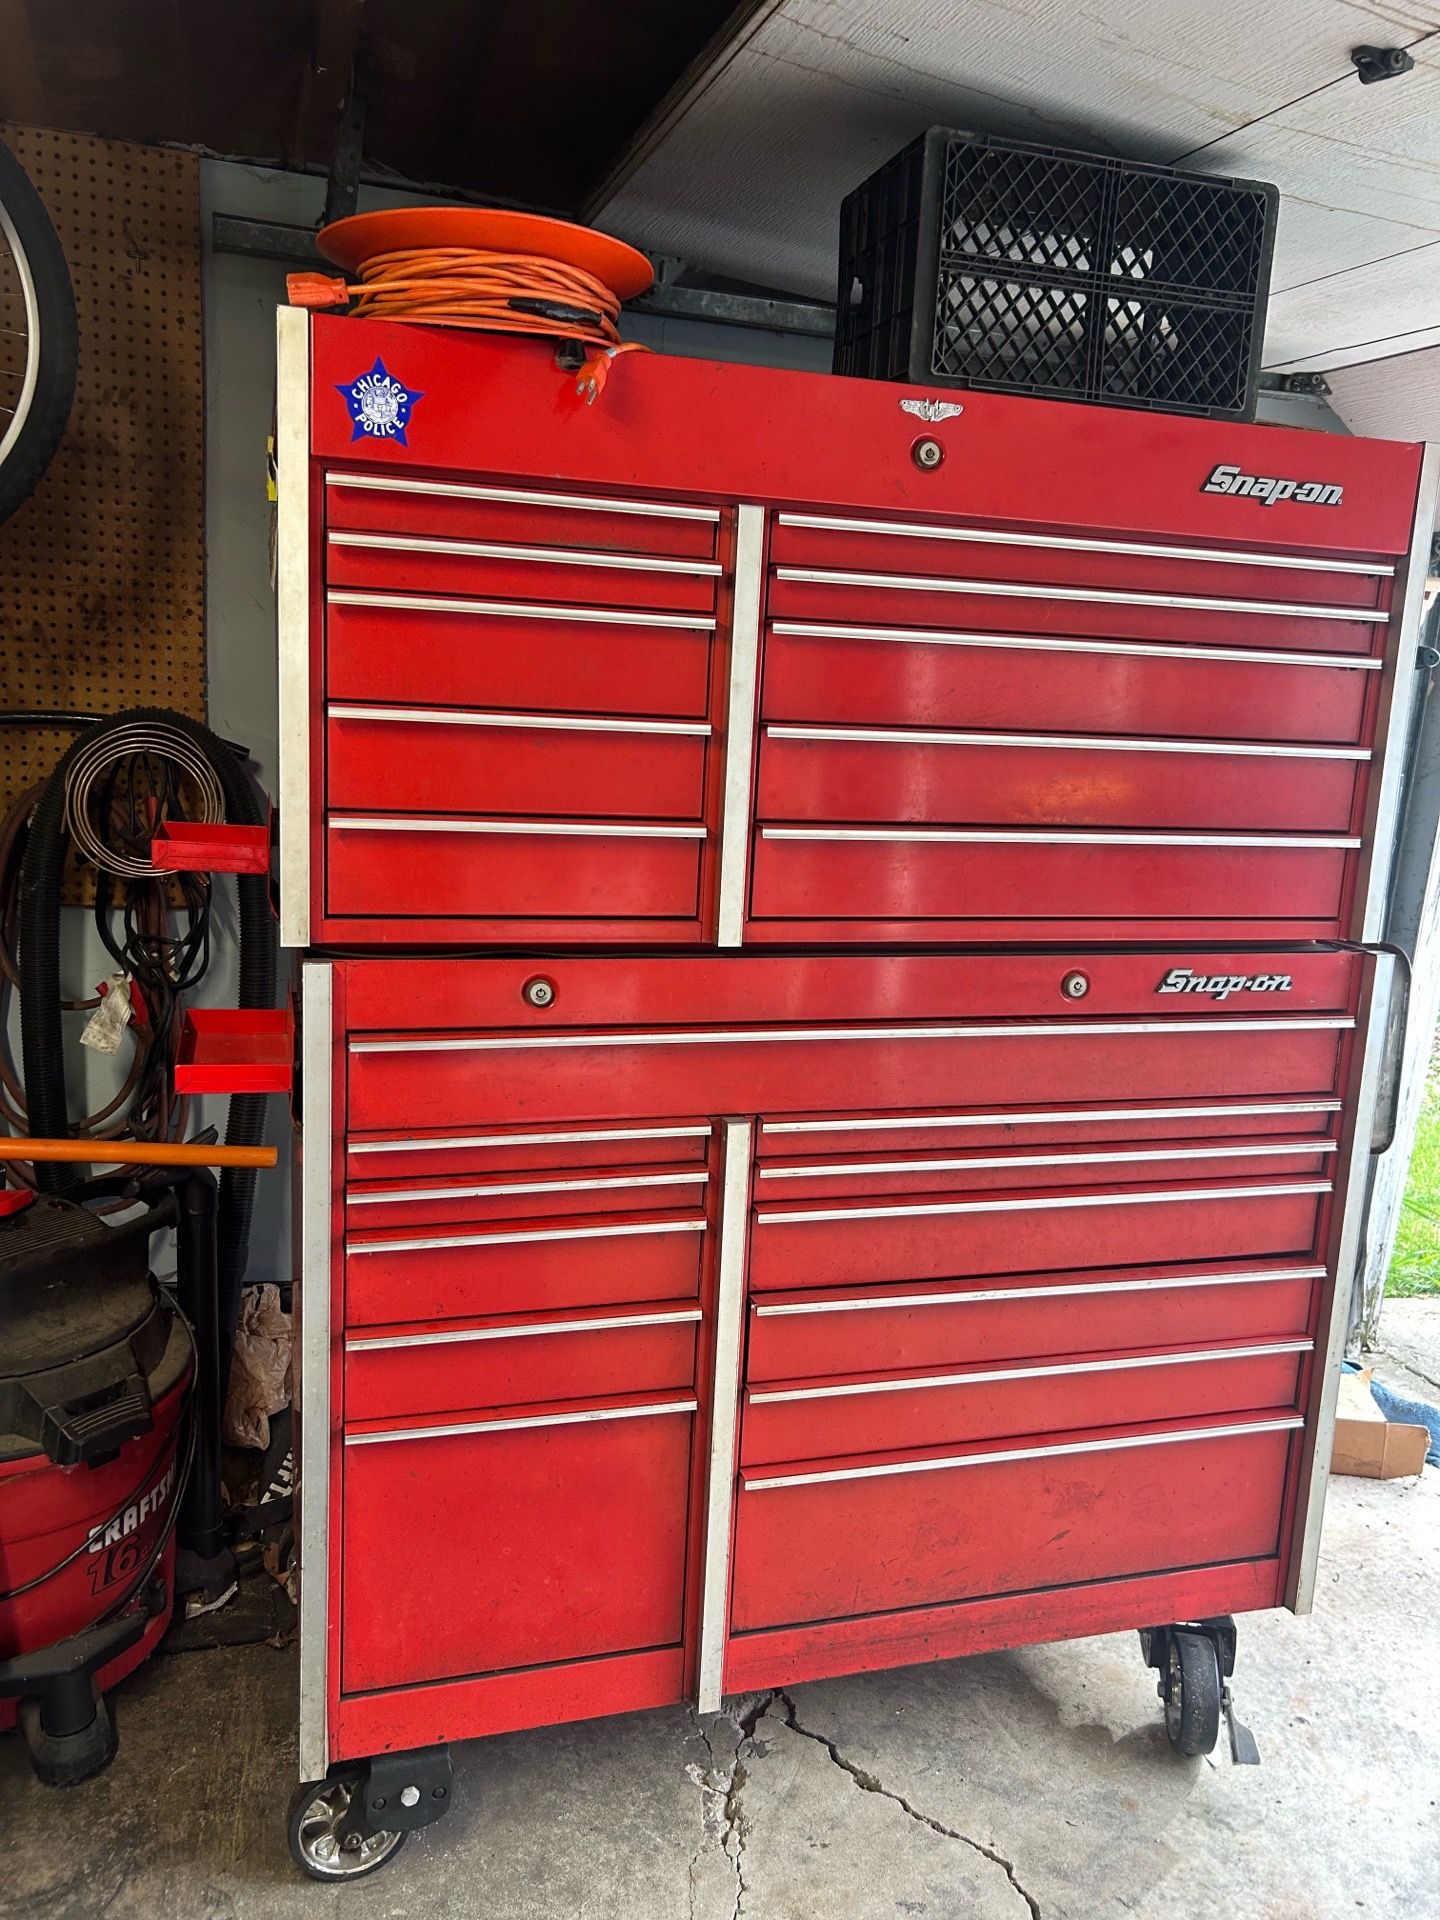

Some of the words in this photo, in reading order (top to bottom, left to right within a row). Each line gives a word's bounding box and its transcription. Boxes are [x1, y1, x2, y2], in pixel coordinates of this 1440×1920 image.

[351, 374, 408, 403] CHICAGO
[355, 413, 404, 435] POLICE
[1202, 465, 1344, 506] Snap-on
[1156, 969, 1292, 1000] Snap-on
[87, 1536, 139, 1595] 16
